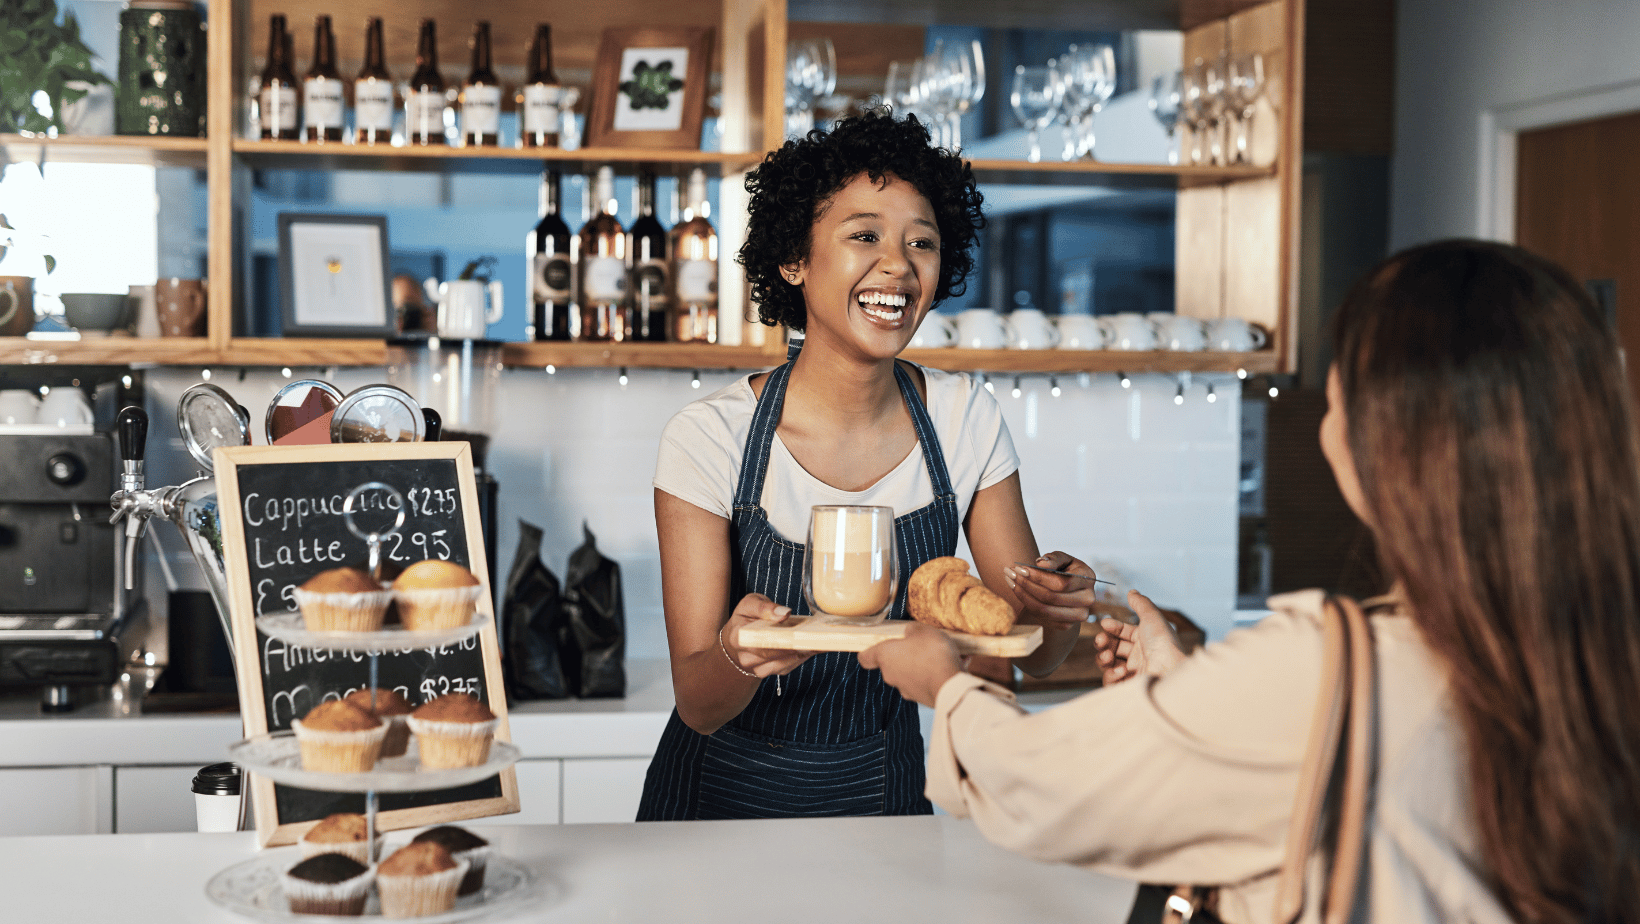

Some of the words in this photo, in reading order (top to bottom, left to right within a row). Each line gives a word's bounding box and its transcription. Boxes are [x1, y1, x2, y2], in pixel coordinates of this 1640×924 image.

[244, 492, 403, 531] Cappucino
[407, 487, 457, 517] $2.75
[255, 537, 346, 569] Latte
[387, 530, 451, 561] 2.95
